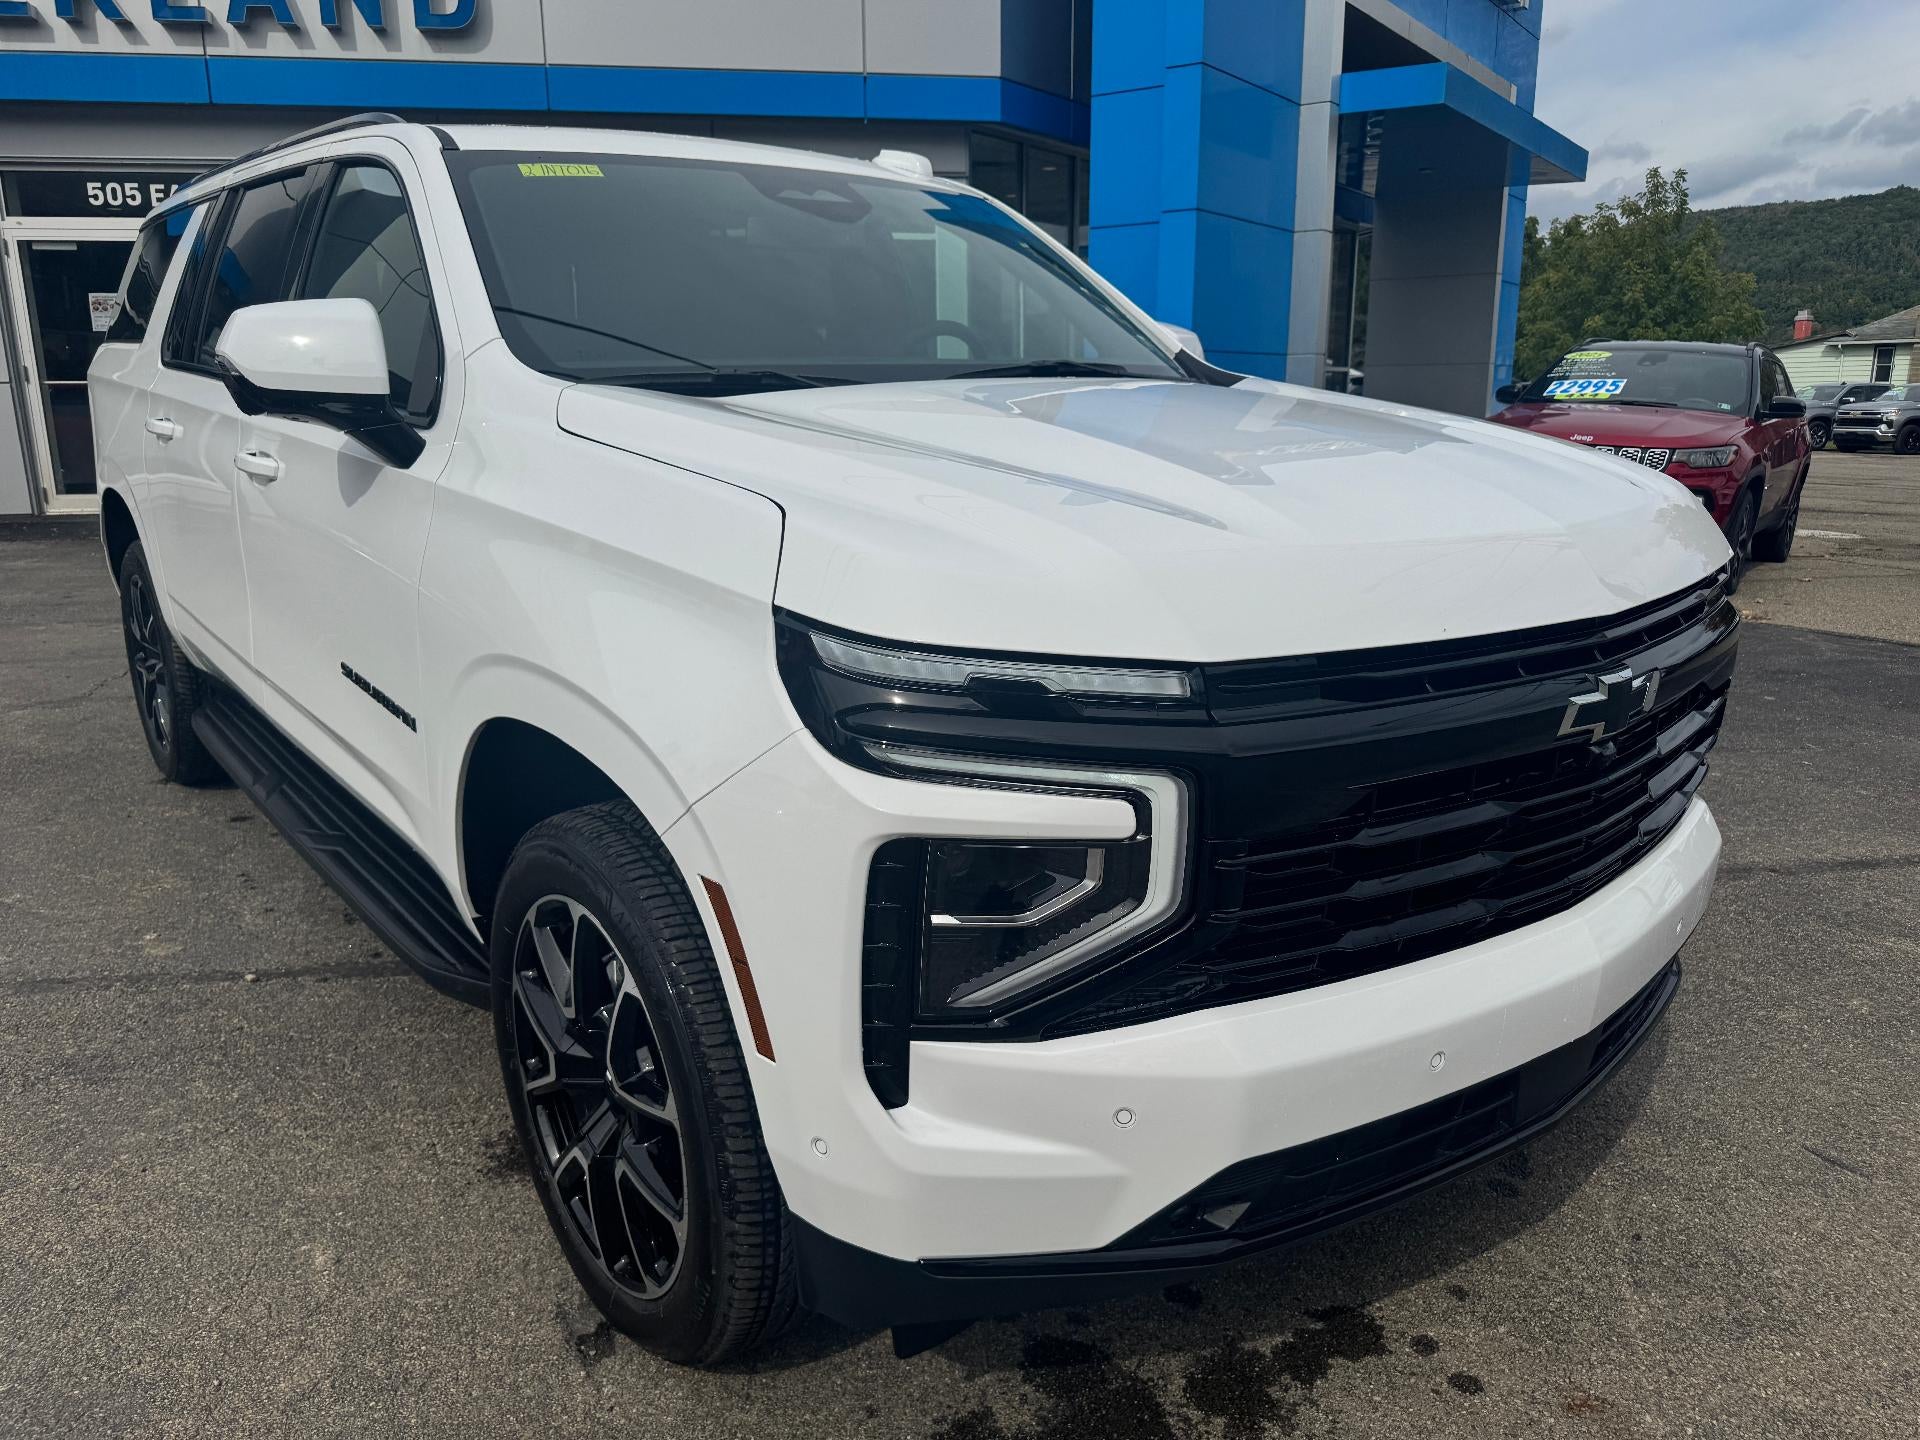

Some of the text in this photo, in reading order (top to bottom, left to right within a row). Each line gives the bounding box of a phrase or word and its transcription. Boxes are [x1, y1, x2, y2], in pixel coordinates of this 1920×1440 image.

[86, 182, 179, 207] 505 E
[1546, 380, 1624, 394] 22995
[1570, 433, 1593, 442] Jeep
